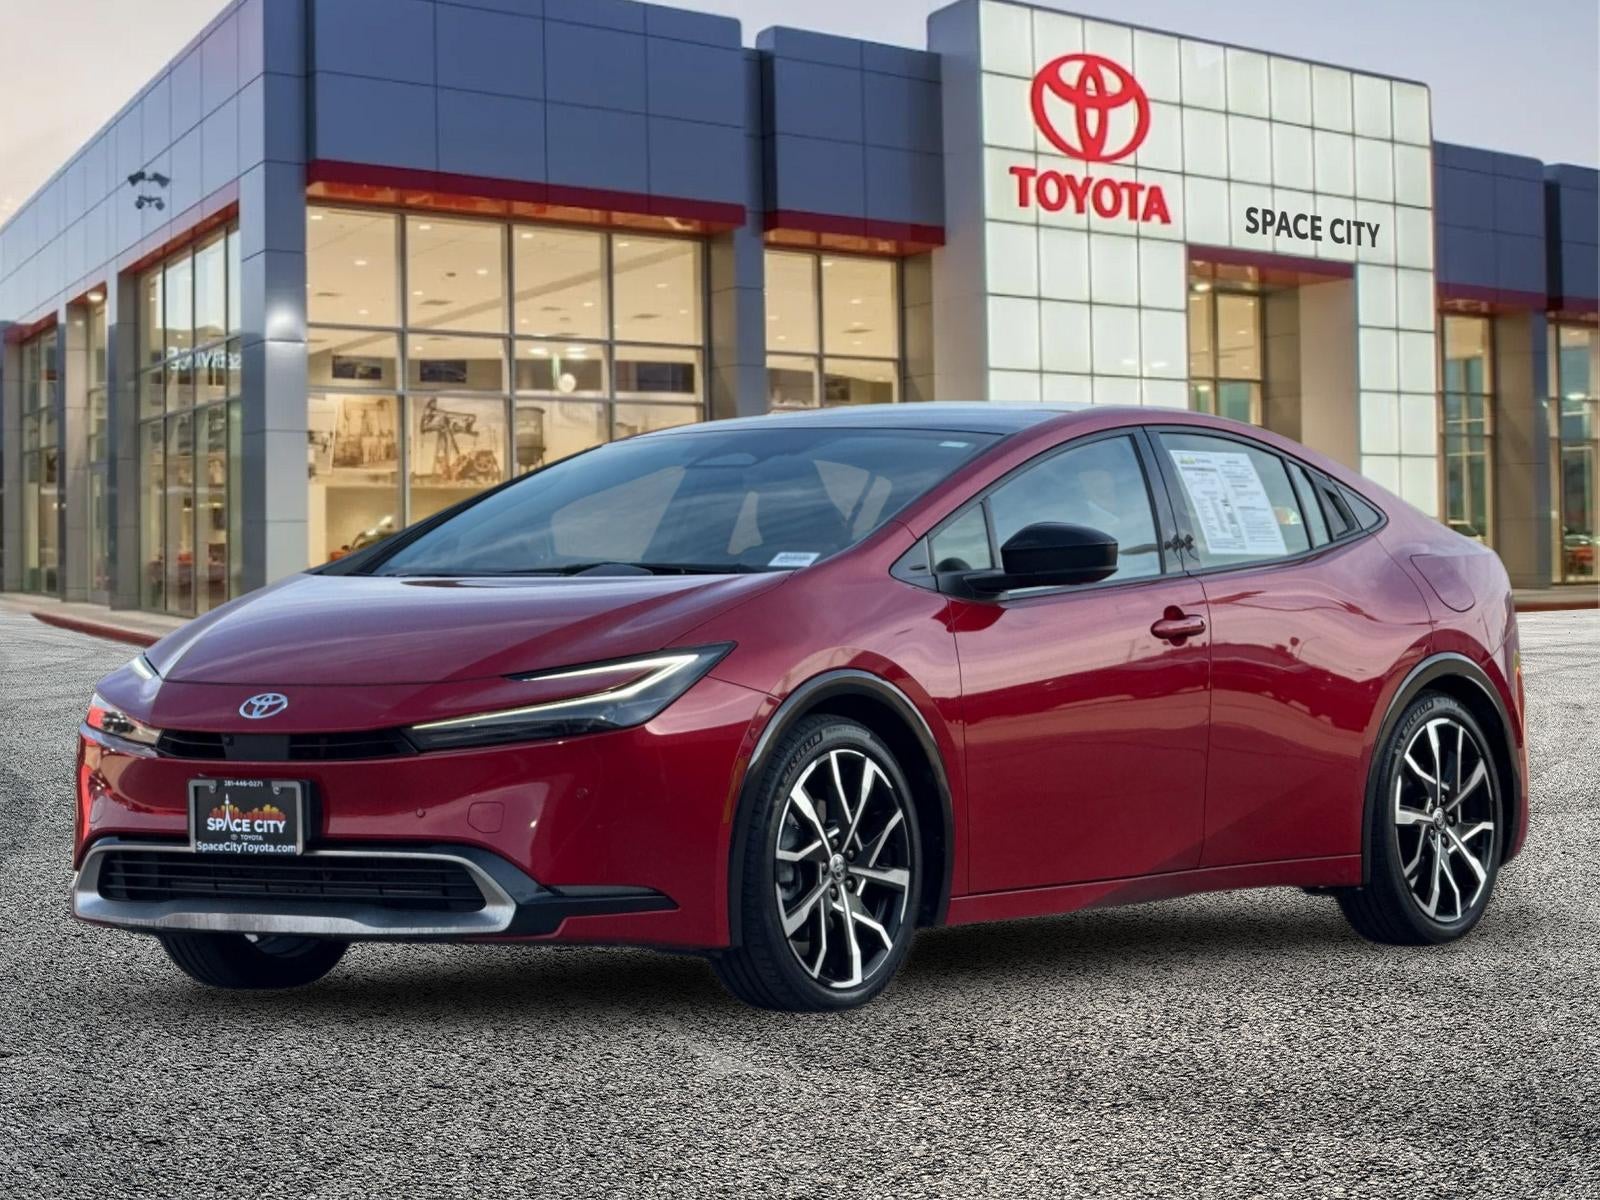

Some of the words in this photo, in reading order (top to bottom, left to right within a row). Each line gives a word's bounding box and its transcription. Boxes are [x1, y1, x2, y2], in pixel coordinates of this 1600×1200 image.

[1009, 166, 1171, 225] TOYOTA
[1245, 206, 1322, 242] SPACE
[1330, 217, 1381, 249] CITY
[207, 816, 250, 832] SPACE
[254, 820, 287, 833] CITY
[197, 841, 296, 854] SpaceCityToyota.com
